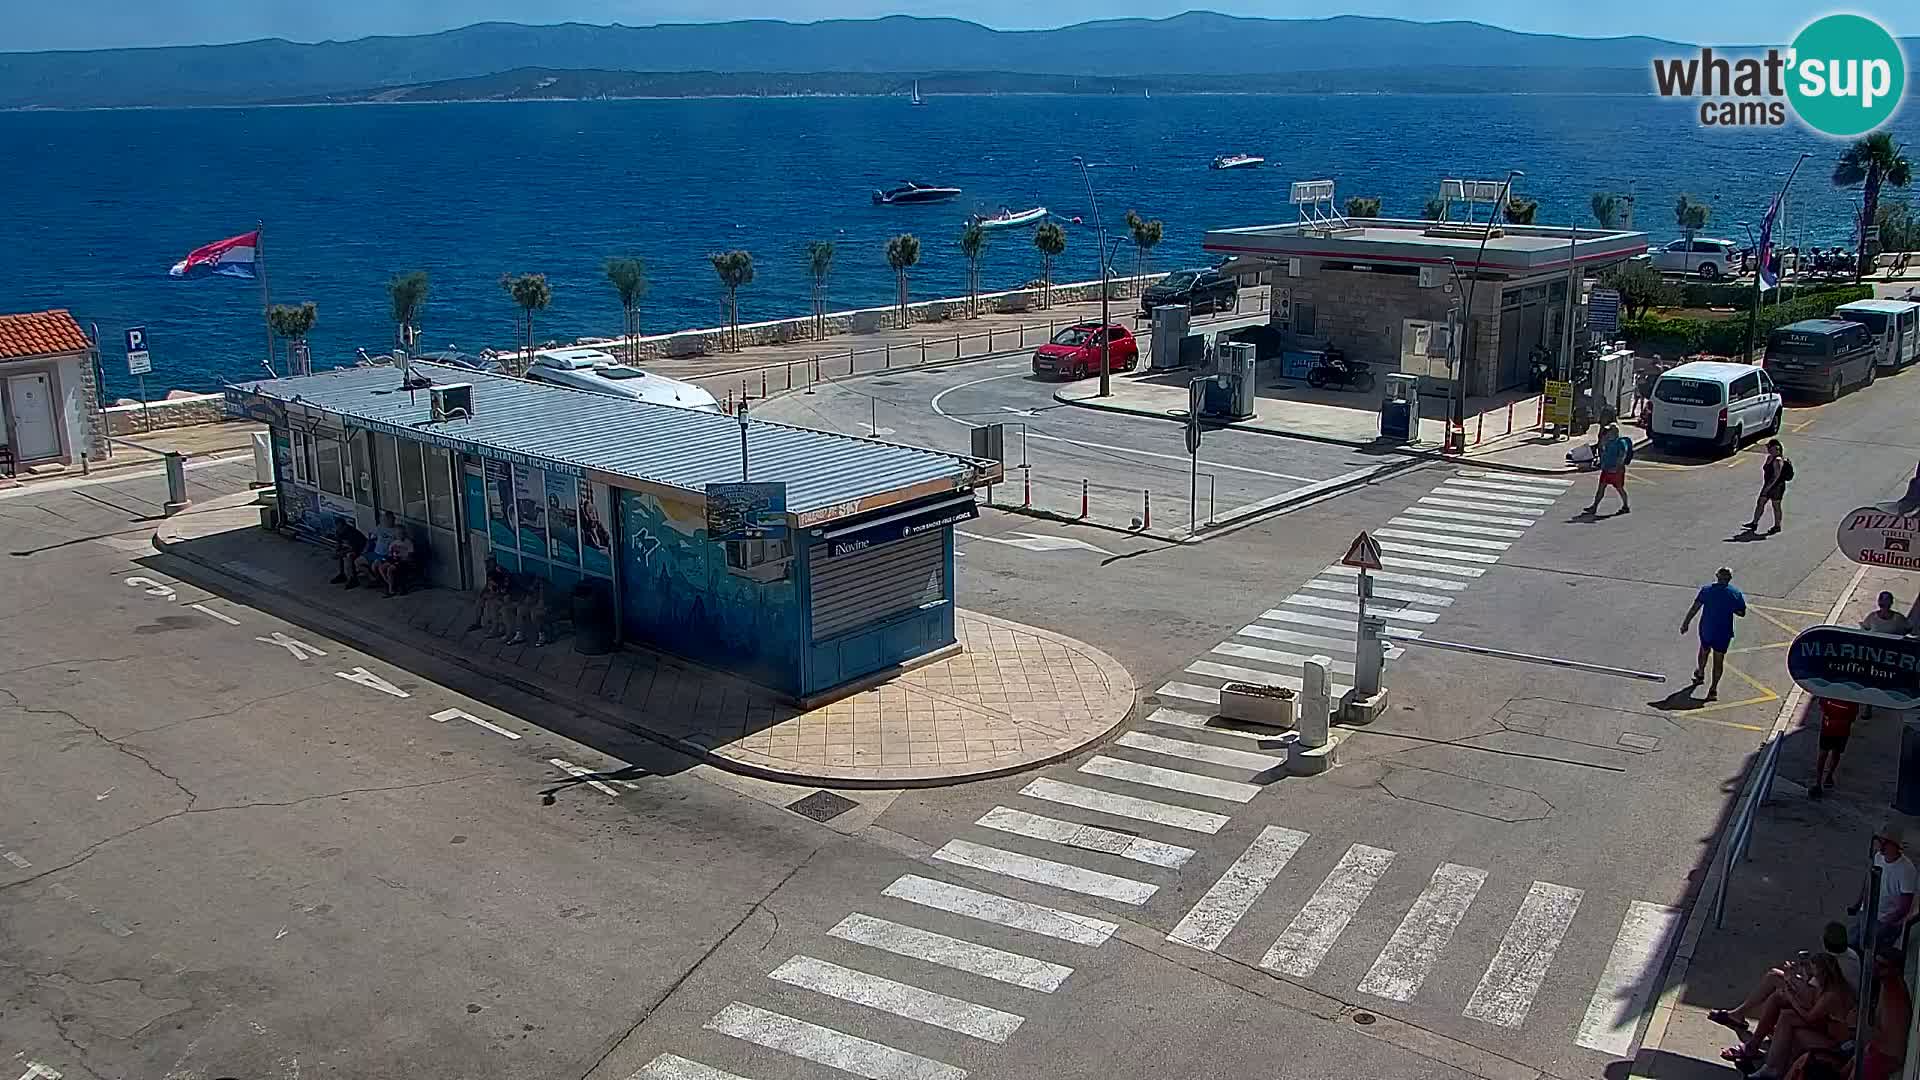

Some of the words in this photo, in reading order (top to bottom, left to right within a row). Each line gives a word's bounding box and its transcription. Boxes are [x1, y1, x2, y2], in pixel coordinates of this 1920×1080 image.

[129, 331, 142, 349] P
[1791, 334, 1809, 342] TAXI
[436, 436, 468, 451] POSTAJA
[478, 446, 493, 457] BUS
[494, 449, 525, 465] STATION
[527, 457, 554, 471] TICKET
[555, 463, 582, 477] OFFICE
[1848, 514, 1920, 533] PIZZE
[1800, 642, 1920, 673] MARINER
[1870, 664, 1897, 679] bar
